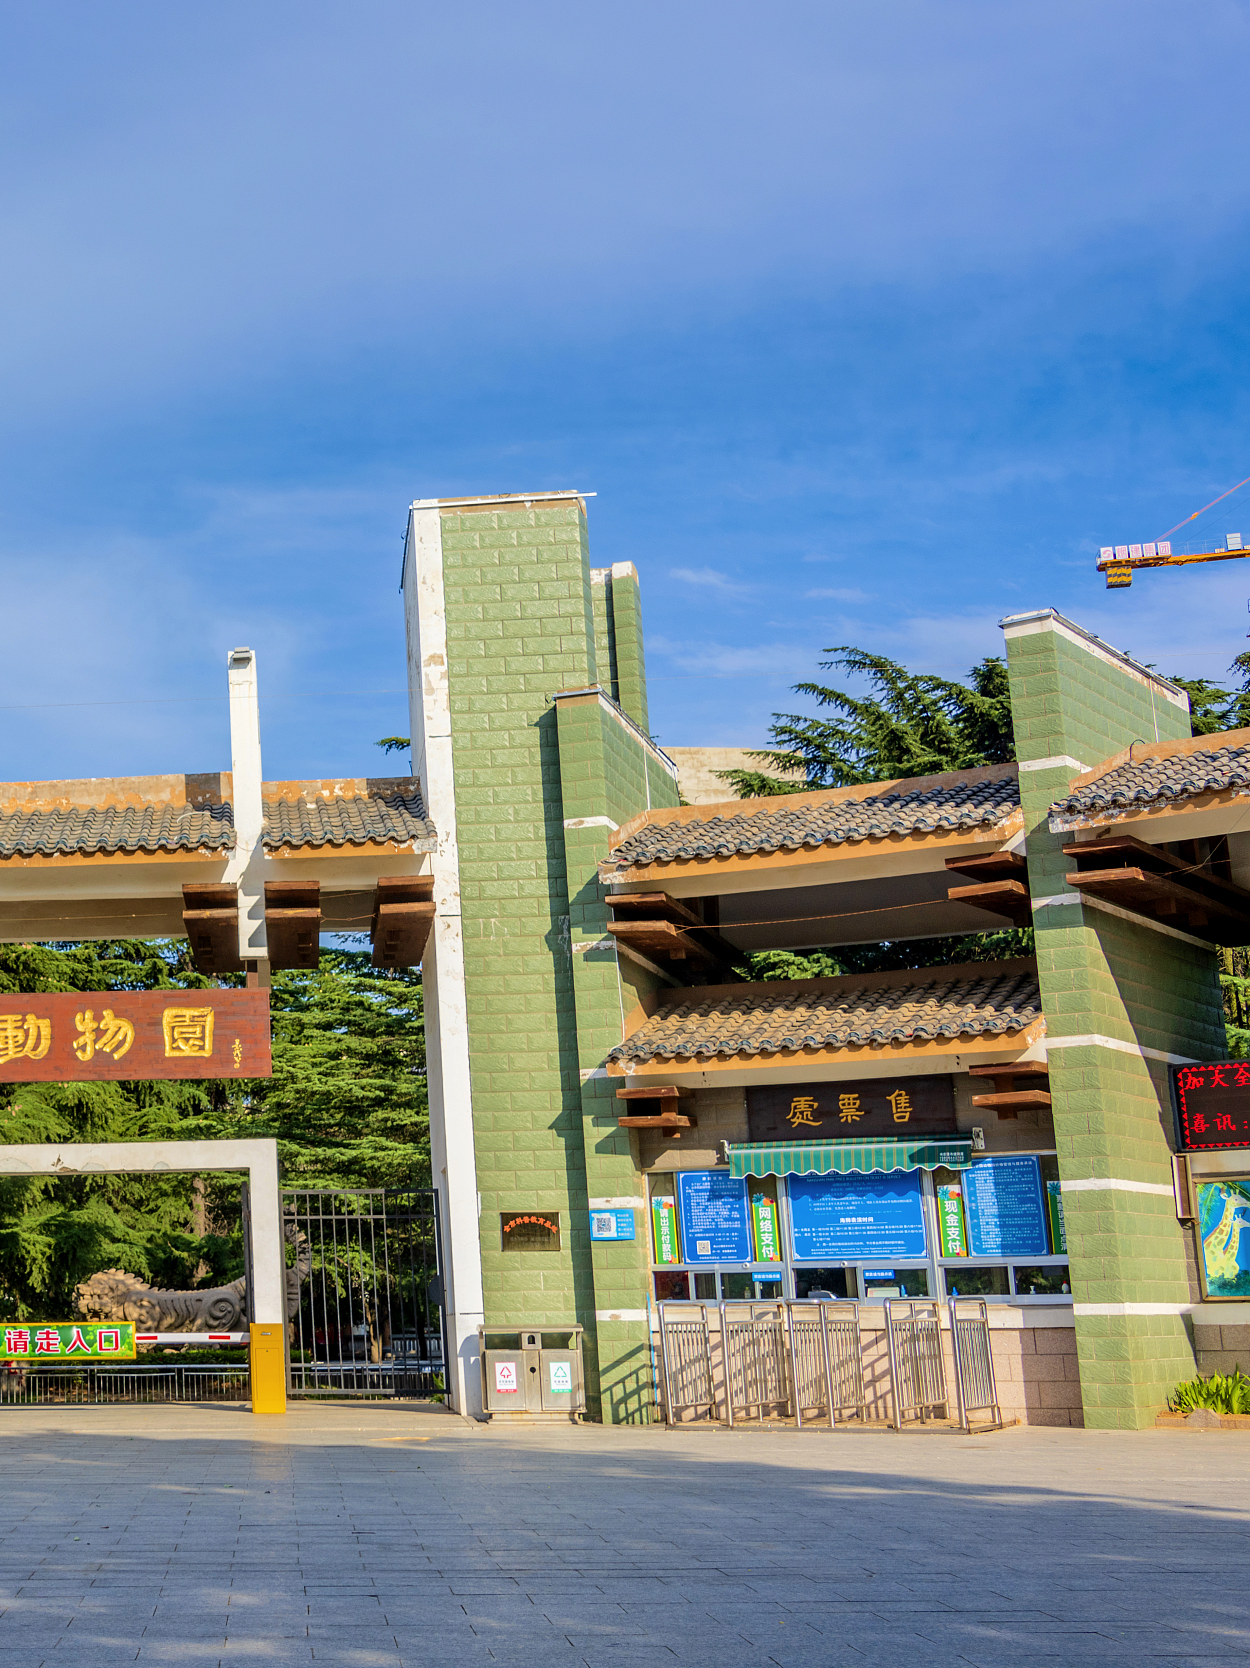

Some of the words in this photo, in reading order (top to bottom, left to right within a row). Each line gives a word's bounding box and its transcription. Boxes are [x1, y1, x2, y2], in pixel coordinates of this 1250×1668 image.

[1184, 1067, 1250, 1090] 加大全
[759, 1207, 774, 1258] 网络支付
[944, 1200, 961, 1253] 现金支付
[5, 1329, 121, 1354] 请走入口
